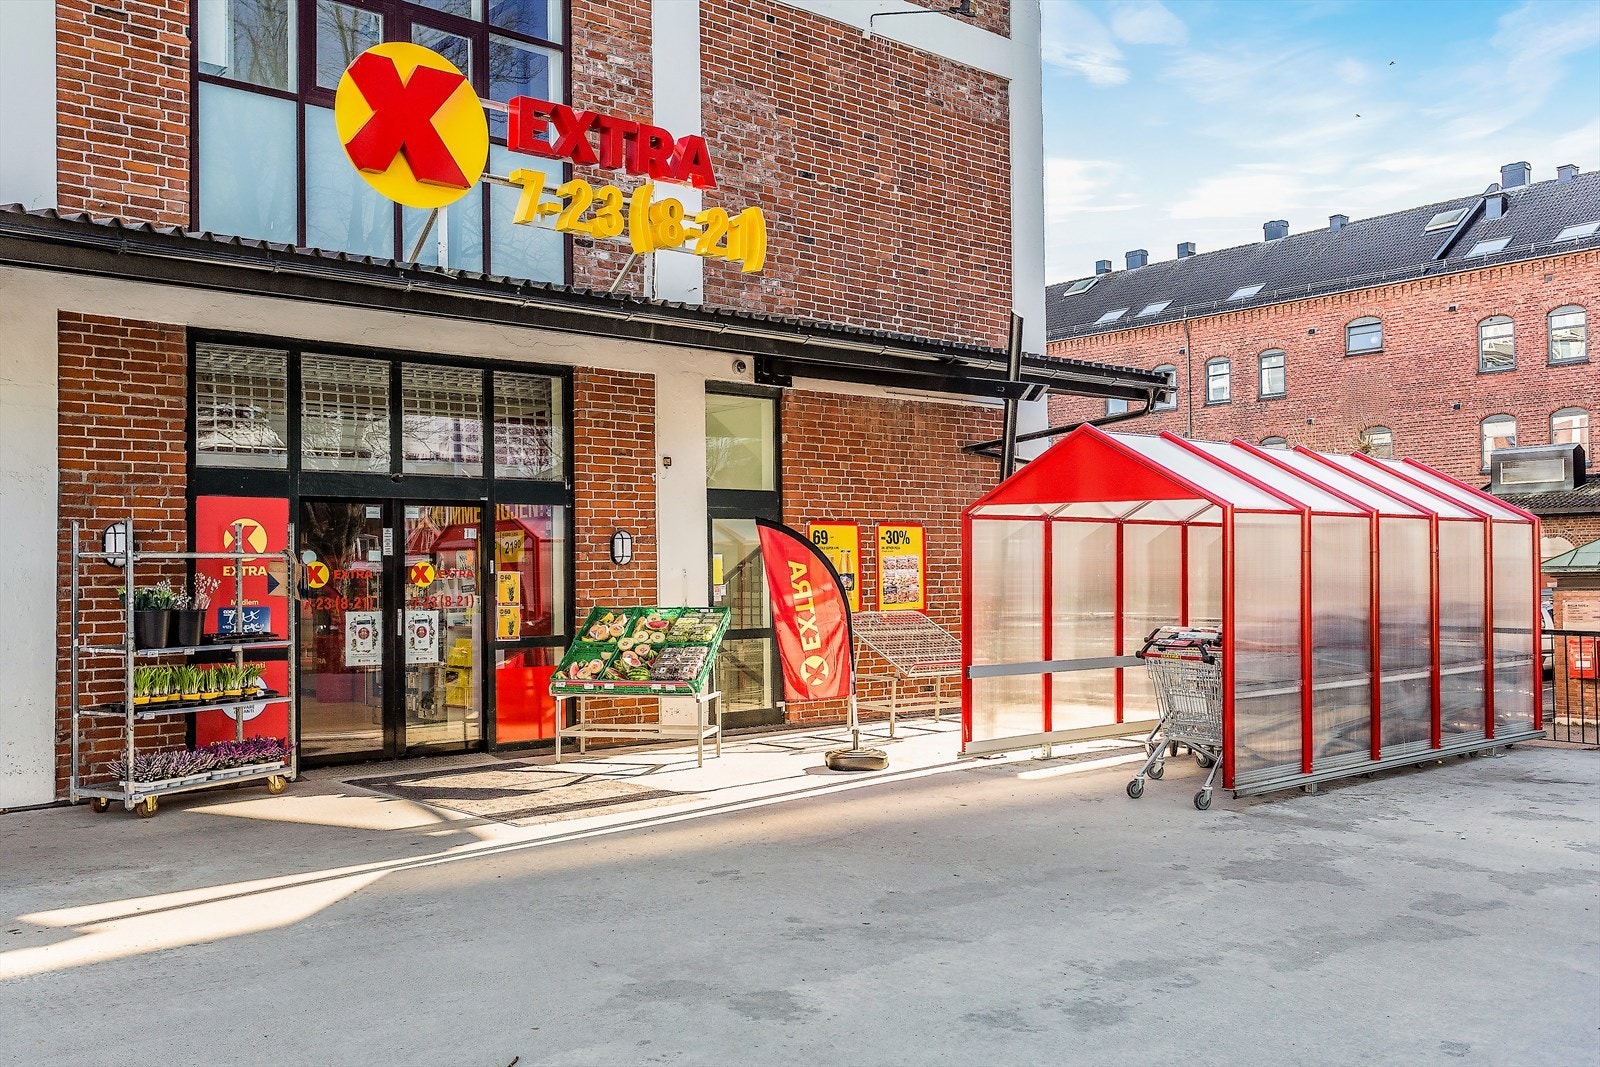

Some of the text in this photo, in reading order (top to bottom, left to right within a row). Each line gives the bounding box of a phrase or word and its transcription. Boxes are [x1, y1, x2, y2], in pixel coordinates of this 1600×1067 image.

[507, 95, 717, 190] EXTRA
[508, 168, 767, 274] 7-23 (8-21)
[881, 530, 910, 545] -30%
[333, 569, 374, 579] EXTRA
[439, 569, 475, 579] EXTRA
[440, 594, 475, 609] (8-21)
